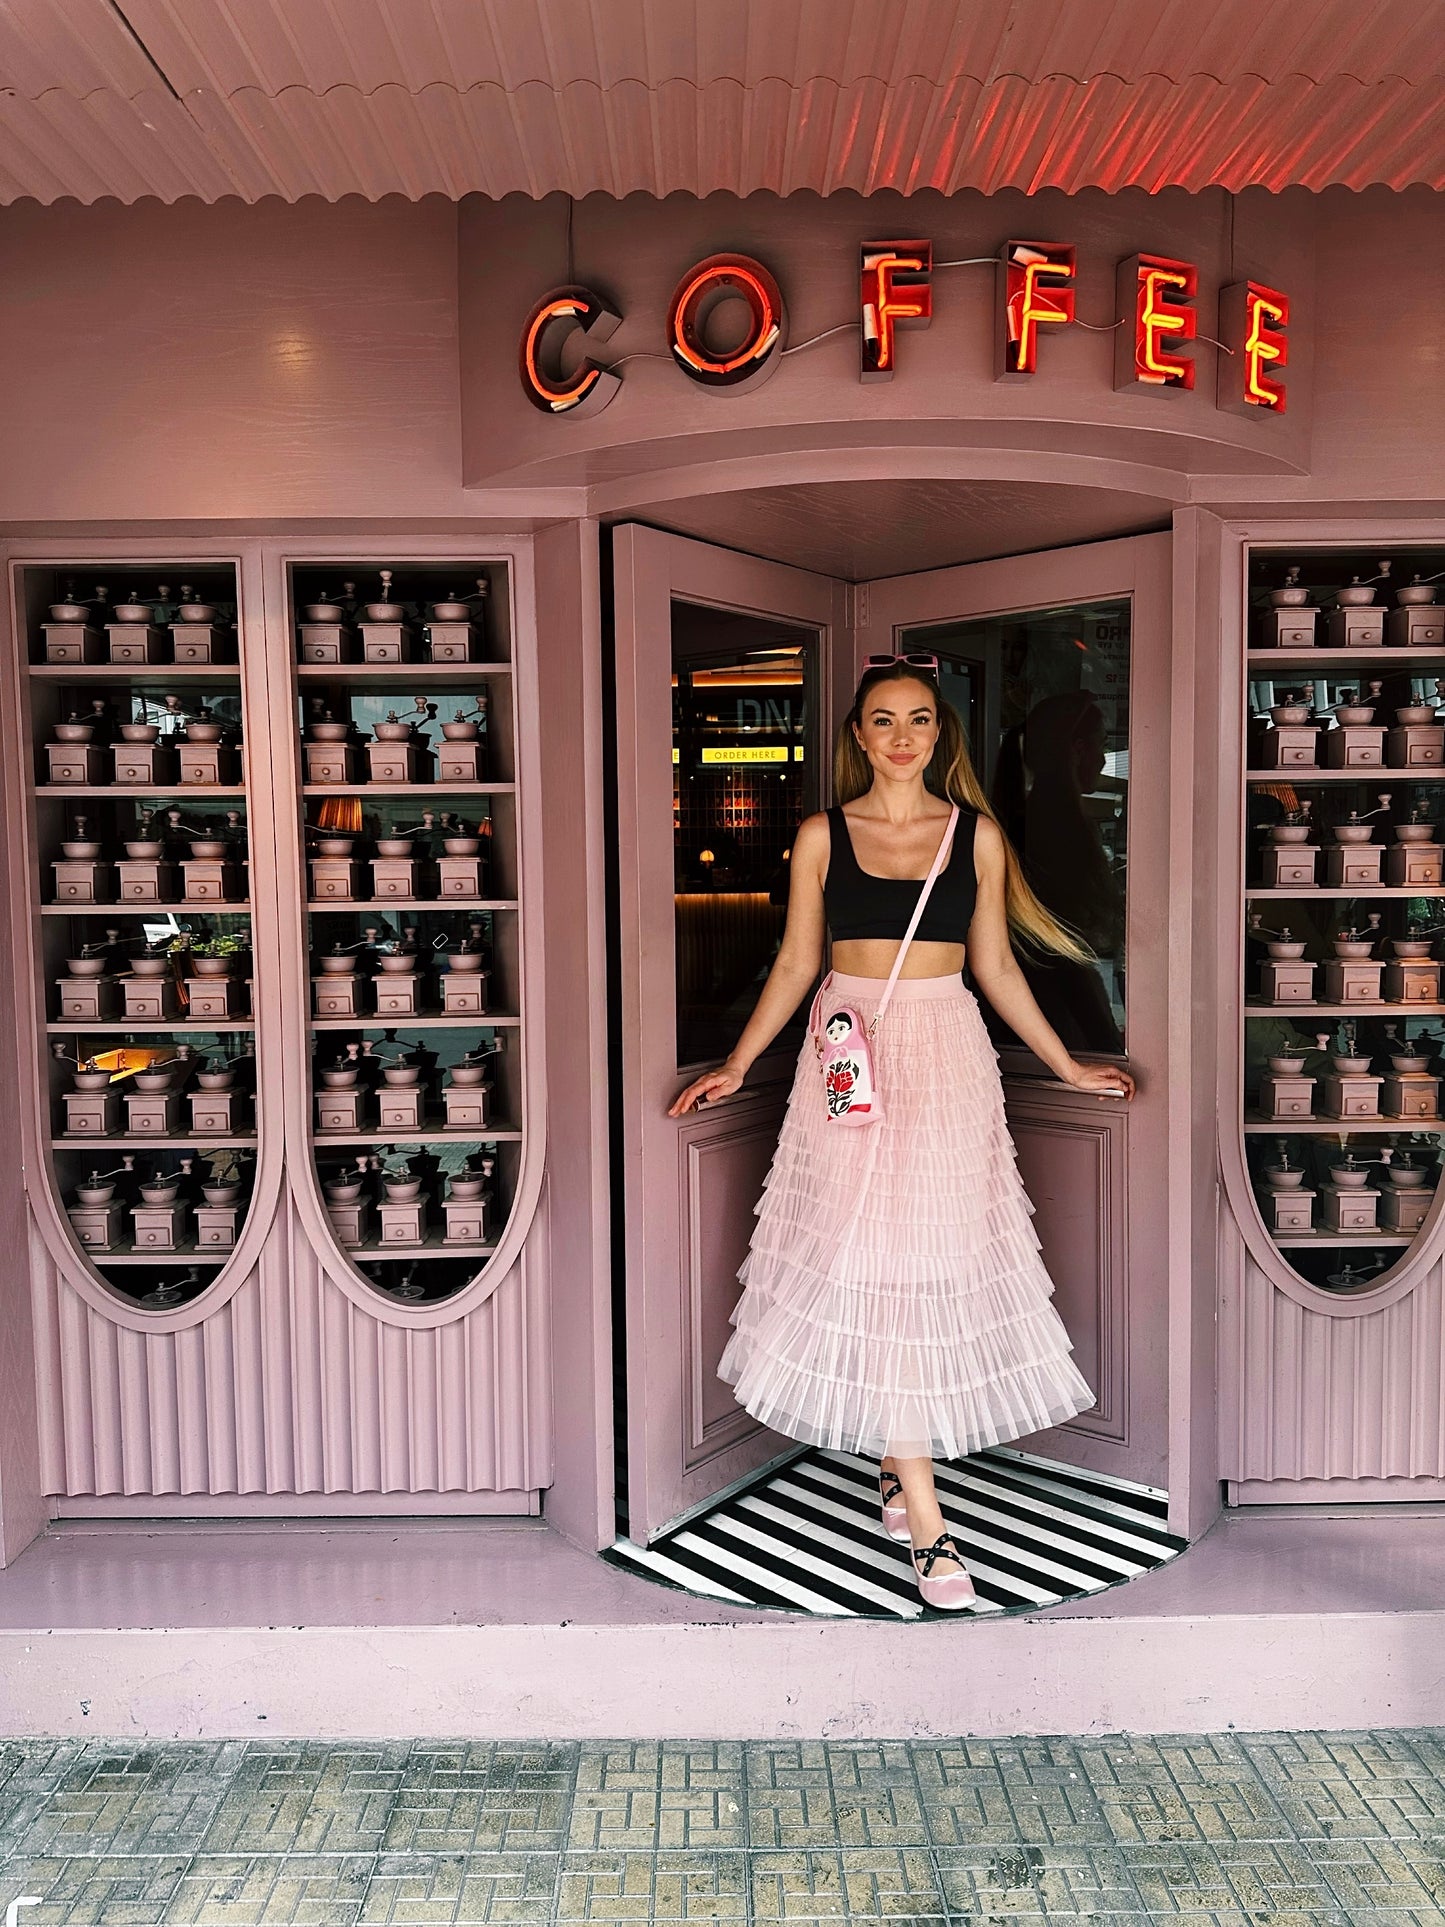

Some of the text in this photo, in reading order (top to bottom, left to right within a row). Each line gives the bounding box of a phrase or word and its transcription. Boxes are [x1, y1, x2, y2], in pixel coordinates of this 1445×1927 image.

[518, 238, 1290, 418] COFFEE
[736, 699, 807, 735] DN
[714, 750, 776, 760] ORDER HERE
